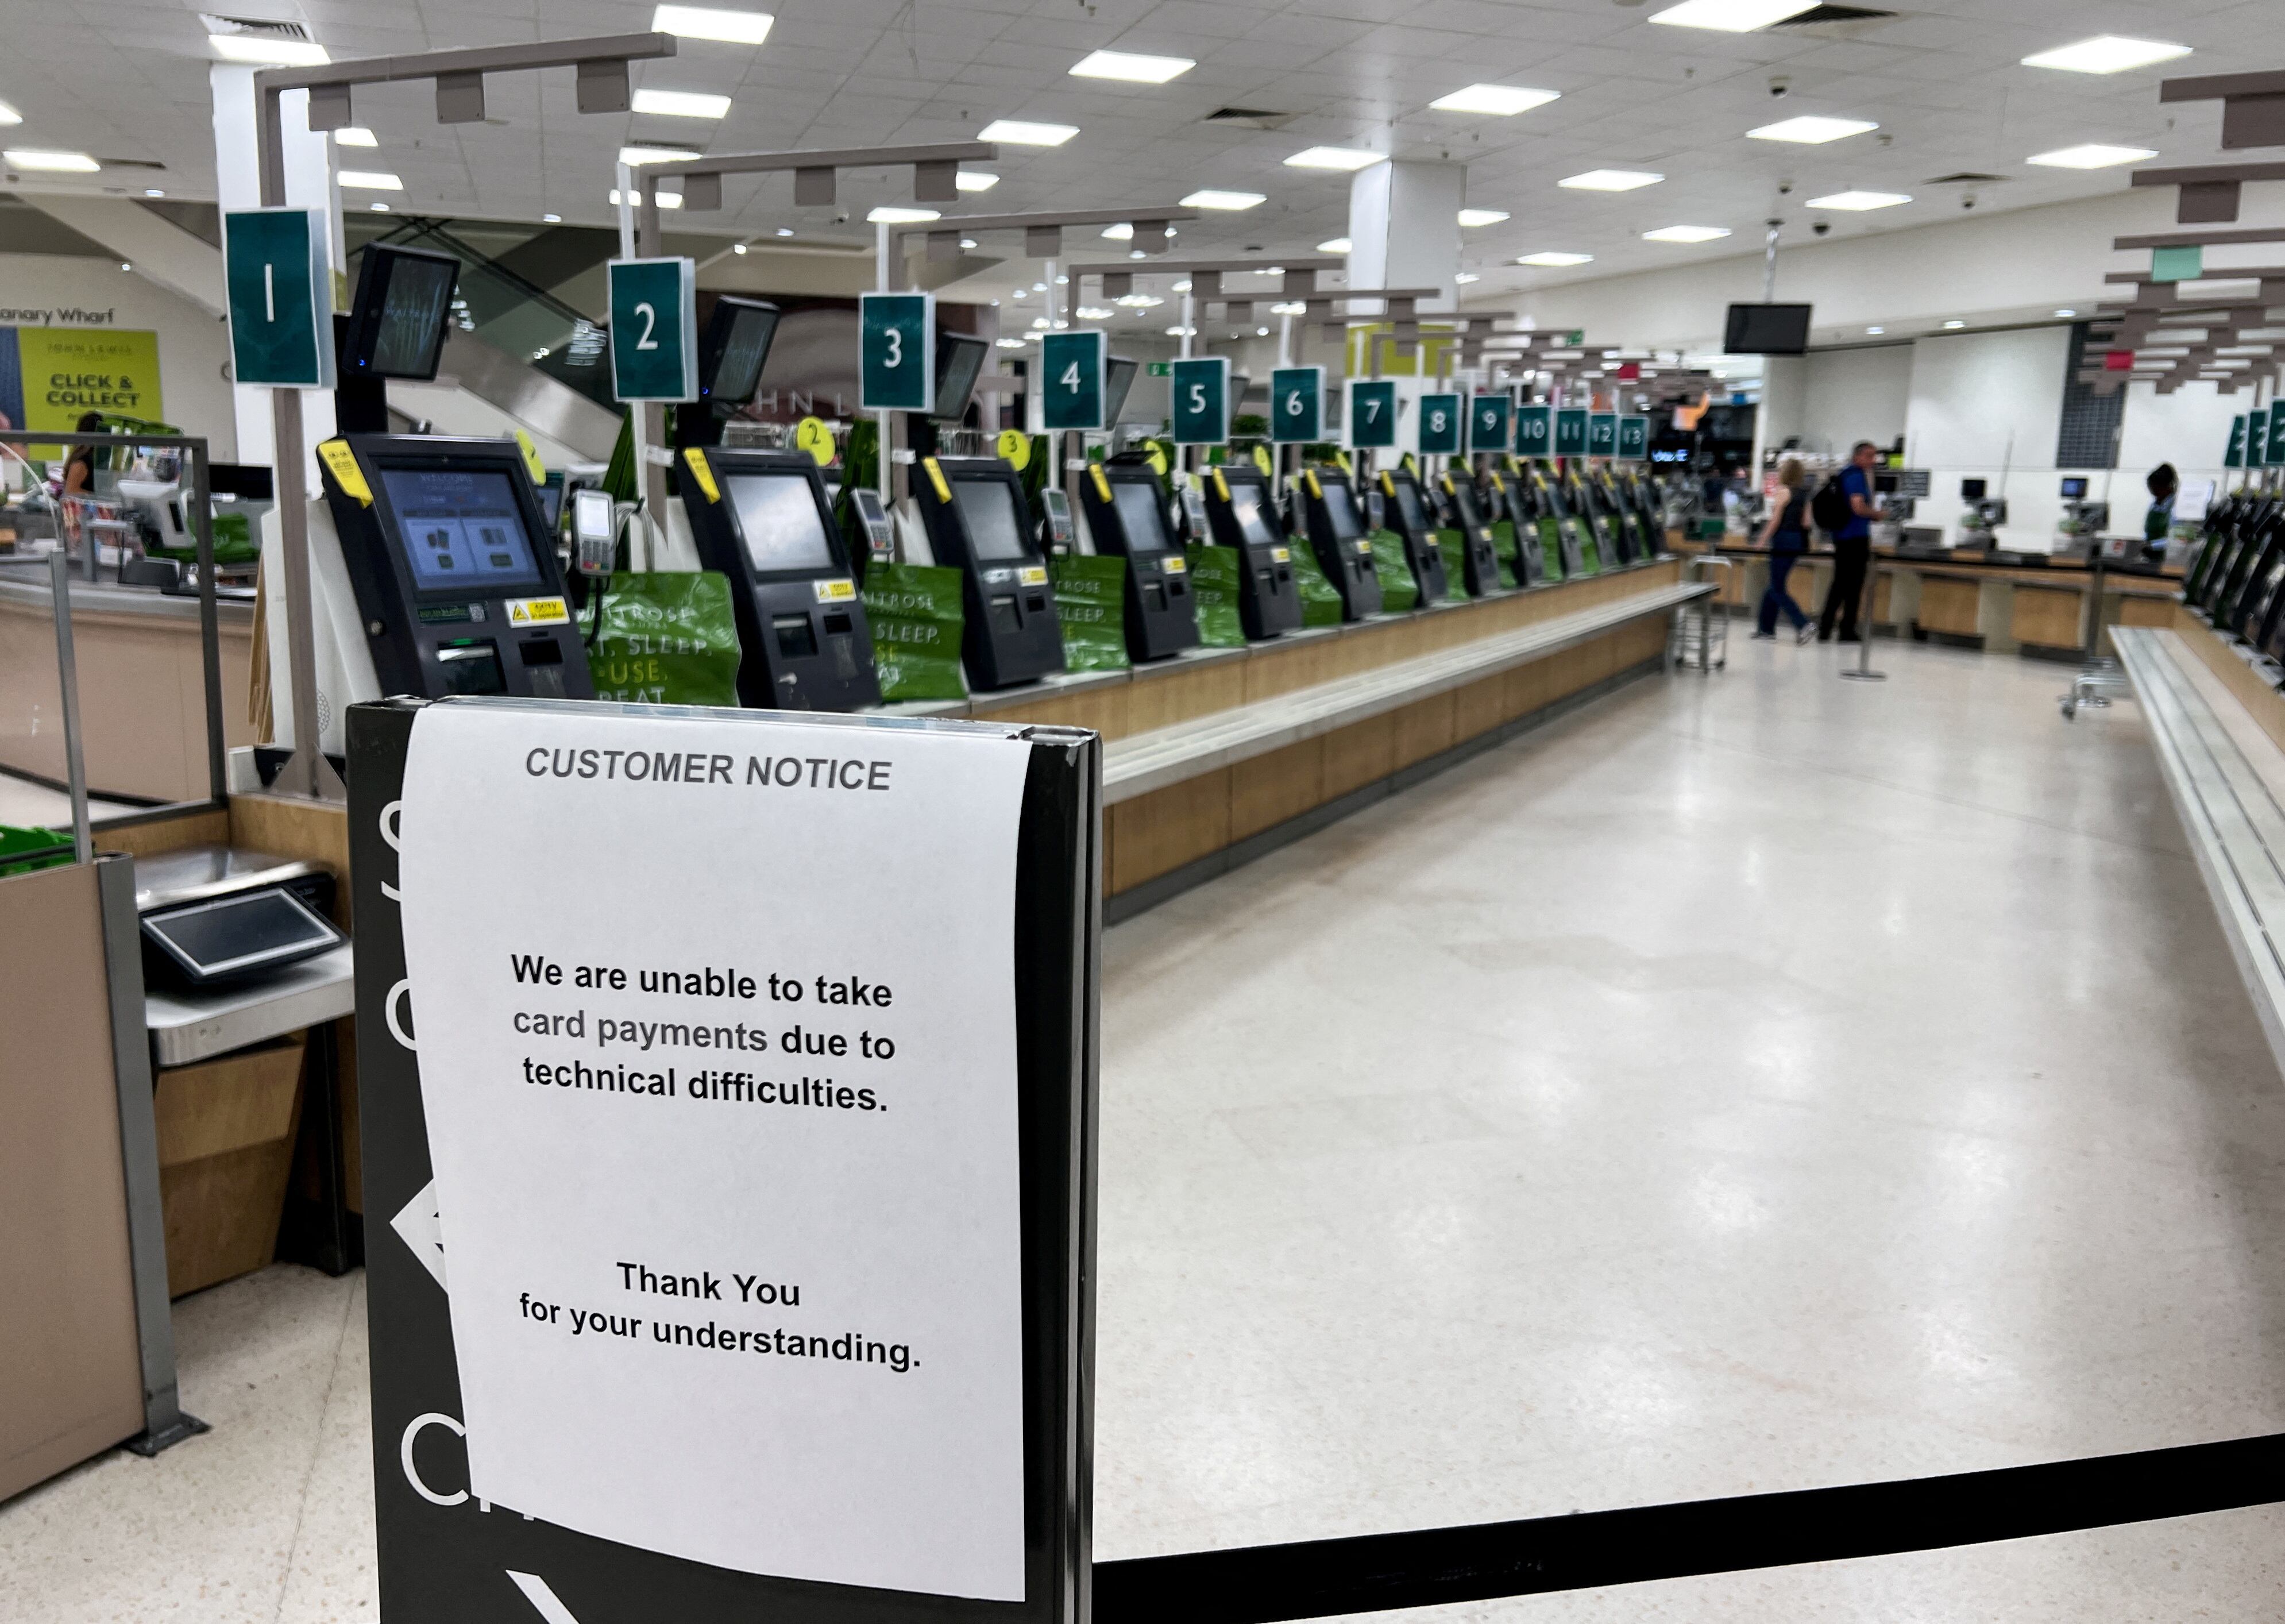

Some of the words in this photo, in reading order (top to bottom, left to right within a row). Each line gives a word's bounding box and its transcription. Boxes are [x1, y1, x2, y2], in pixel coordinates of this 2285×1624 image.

[265, 263, 275, 322] 1
[0, 308, 52, 326] anary
[57, 307, 115, 323] Wharf
[634, 302, 658, 350] 2
[883, 327, 902, 368] 3
[50, 373, 113, 389] CLICK
[119, 376, 133, 389] &
[1061, 361, 1081, 395] 4
[46, 390, 140, 407] COLLECT
[1189, 384, 1206, 414] 5
[1286, 390, 1303, 416] 6
[1365, 399, 1381, 425] 7
[1430, 410, 1446, 433] 8
[1481, 409, 1497, 431] 9
[808, 423, 821, 446] 2
[1523, 418, 1545, 439] 10
[1561, 421, 1580, 441] 11
[1592, 425, 1612, 442] 12
[1623, 427, 1642, 445] 13
[1007, 434, 1018, 453] 3
[1056, 580, 1101, 593] TROSE
[874, 621, 941, 645] SLEEP,
[629, 634, 712, 657] SLEEP,
[526, 747, 734, 784] CUSTOMER
[746, 756, 893, 790] NOTICE
[511, 954, 563, 986] We
[575, 966, 627, 990] are
[640, 967, 756, 999] unable
[768, 973, 803, 1002] to
[815, 975, 892, 1007] take
[514, 1009, 585, 1038] card
[599, 1019, 767, 1051] payments
[781, 1024, 848, 1056] due
[859, 1030, 895, 1059] to
[523, 1056, 676, 1097] technical
[689, 1070, 887, 1112] difficulties.
[616, 1262, 722, 1300] Thank
[732, 1274, 800, 1306] You
[519, 1292, 561, 1324] for
[569, 1308, 642, 1337] your
[653, 1321, 920, 1373] understanding.
